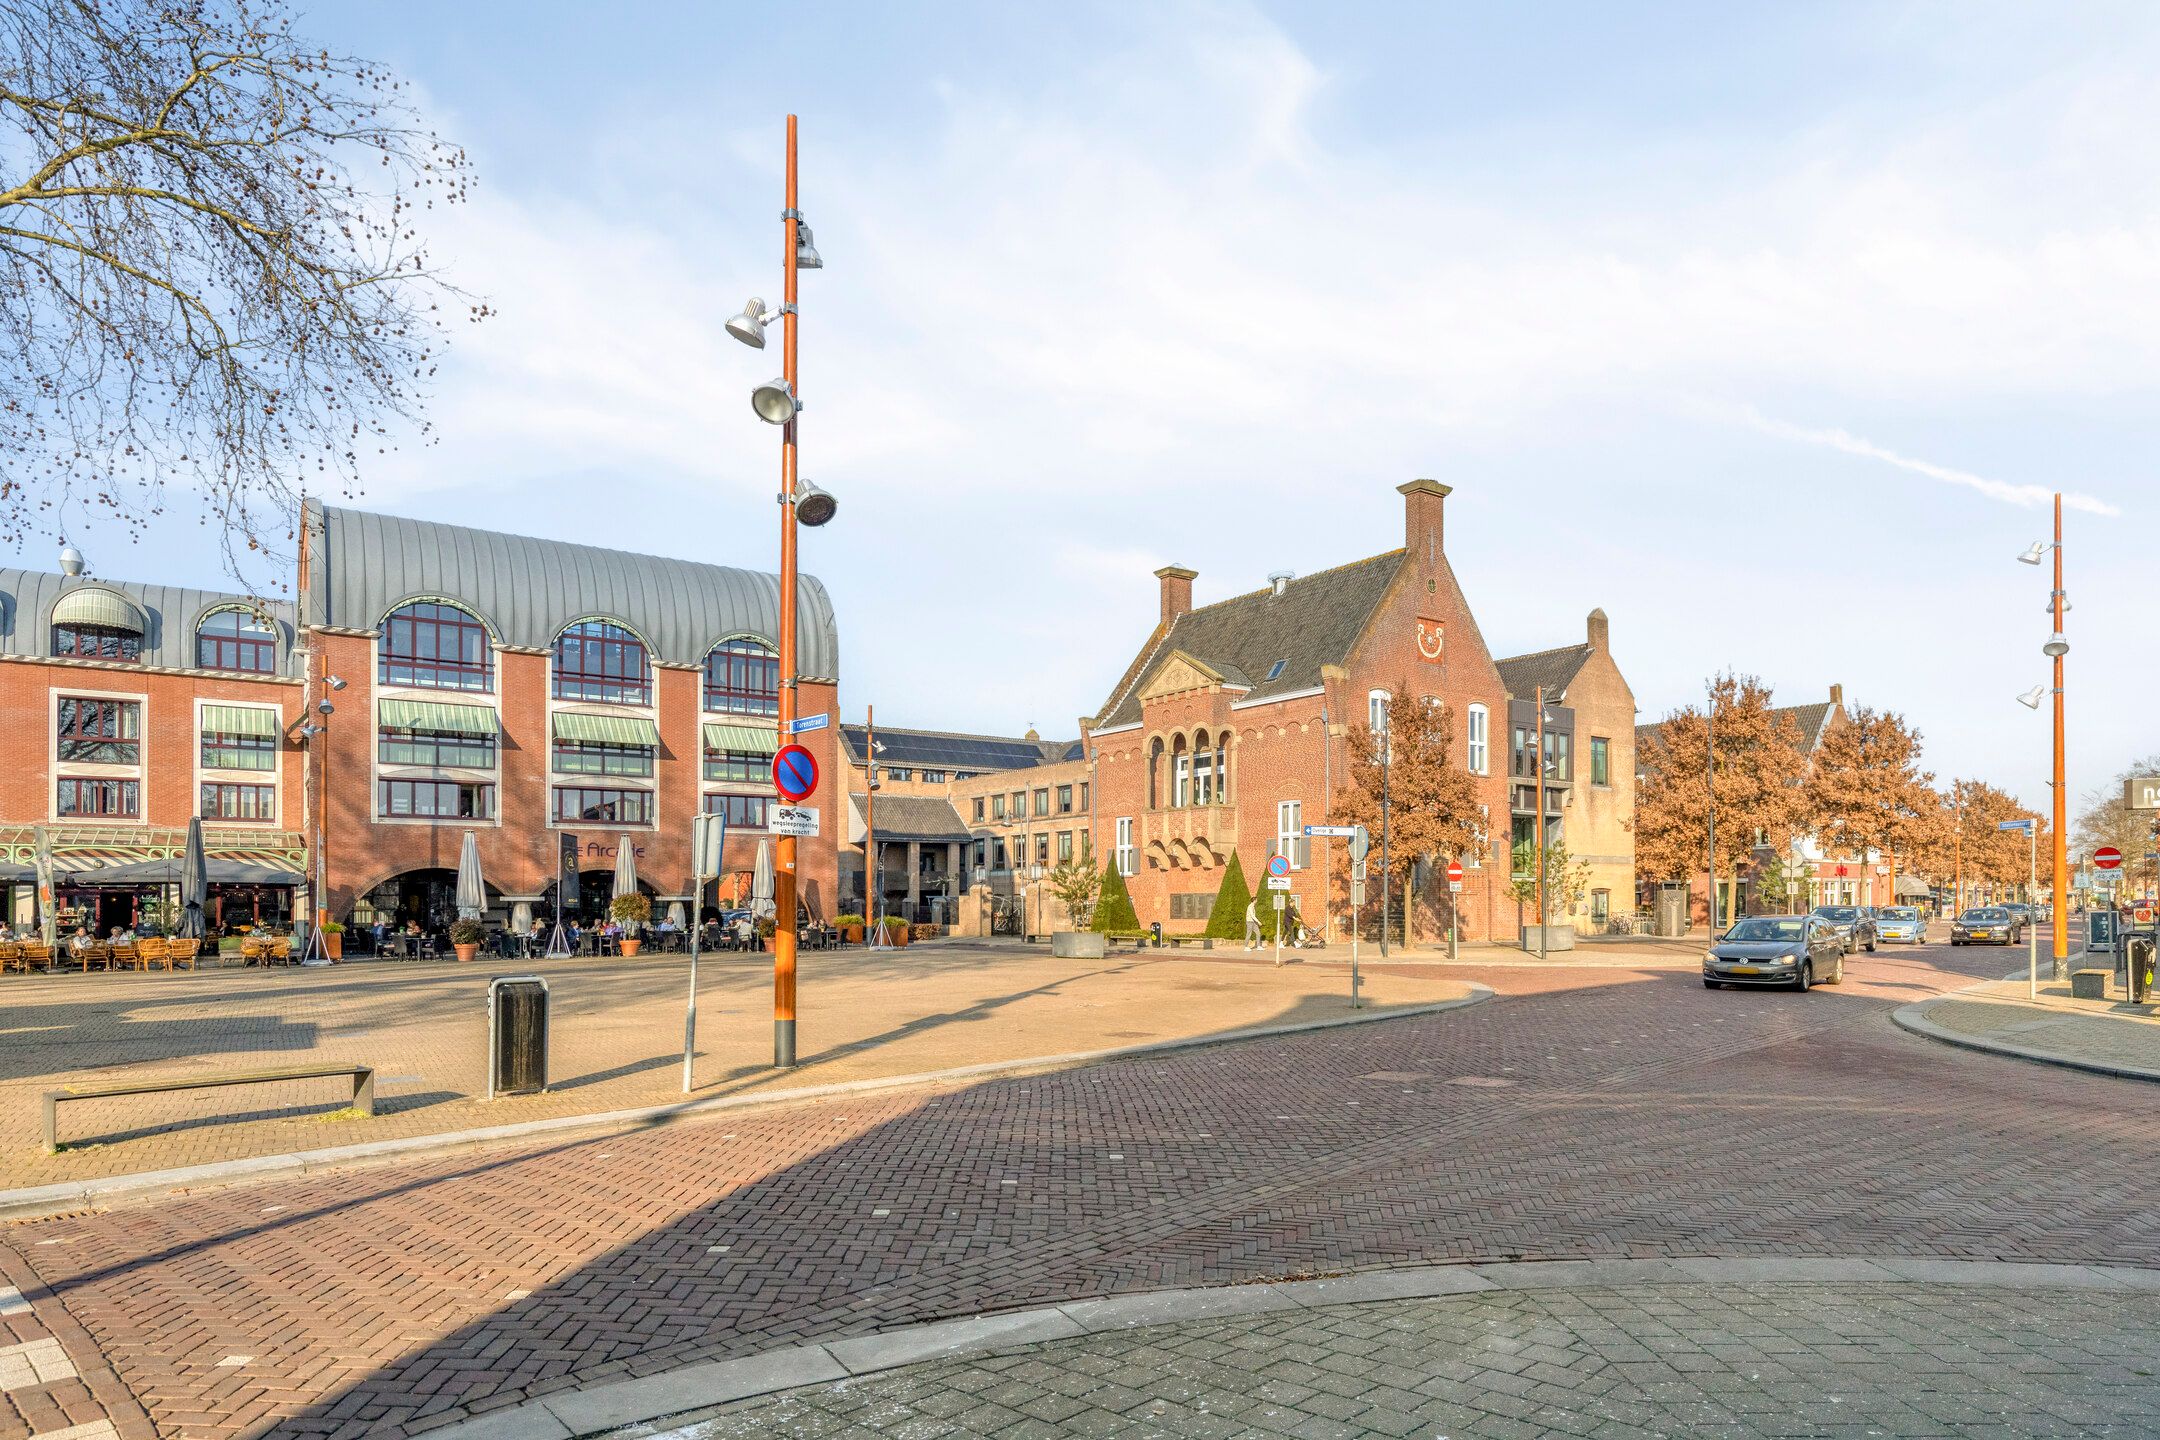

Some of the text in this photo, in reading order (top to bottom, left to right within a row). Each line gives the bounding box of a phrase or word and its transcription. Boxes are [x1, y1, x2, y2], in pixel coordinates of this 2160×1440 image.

[796, 718, 823, 729] Torenstraat
[772, 820, 818, 830] wegsleepregeling
[588, 842, 645, 858] Arcde
